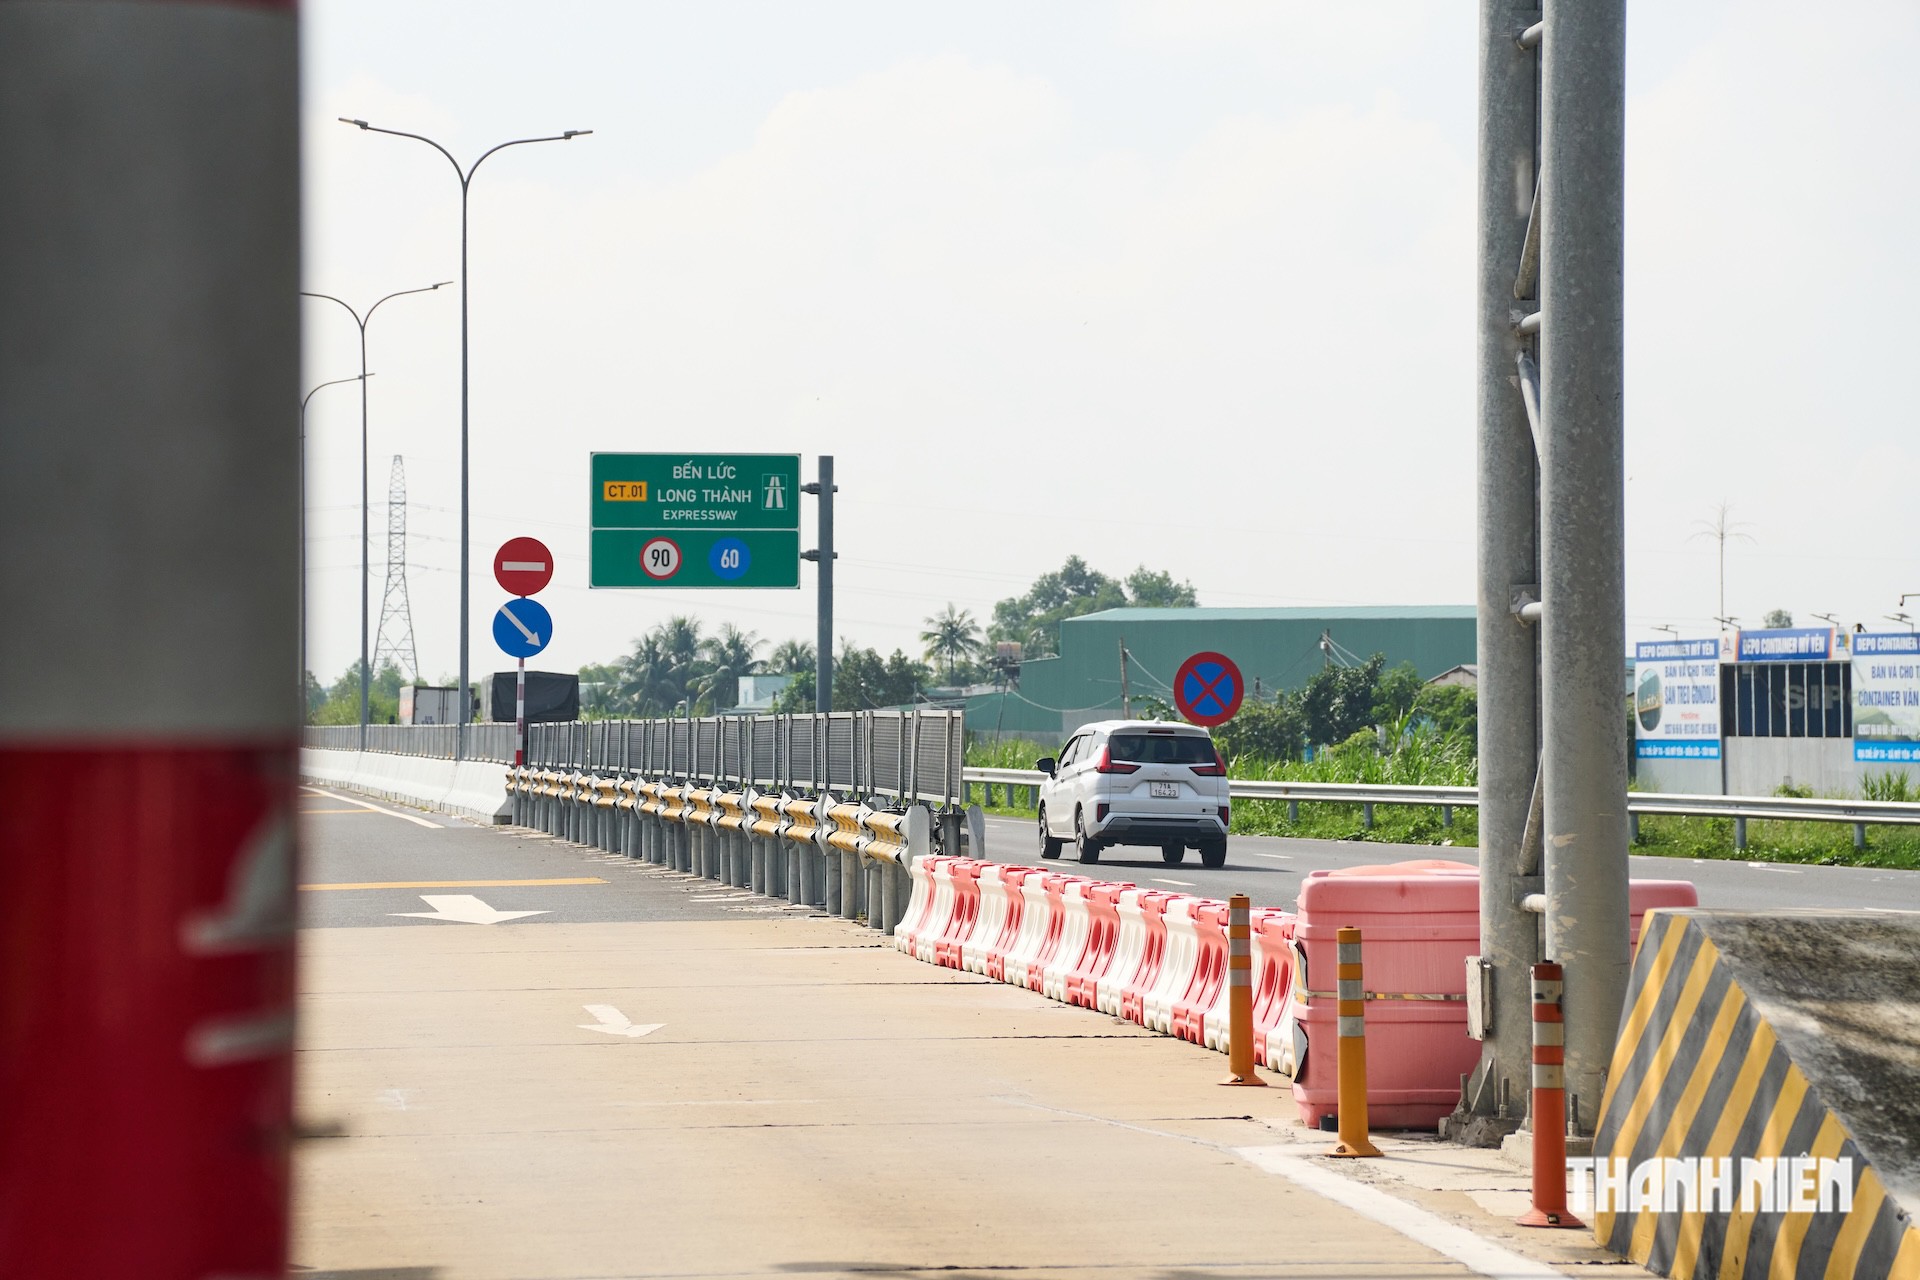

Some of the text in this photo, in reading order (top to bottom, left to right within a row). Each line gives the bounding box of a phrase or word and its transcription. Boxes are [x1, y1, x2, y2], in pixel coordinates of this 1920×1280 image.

[673, 460, 736, 480] BẾN LỨC
[608, 485, 643, 498] CT.01
[657, 485, 752, 503] LONG THÀNH
[663, 510, 738, 520] EXPRESSWAY
[651, 549, 670, 567] 90
[720, 549, 739, 568] 60
[1640, 645, 1655, 658] DEPO
[1742, 638, 1760, 654] DEPO
[1761, 636, 1797, 654] CONTAINER
[1857, 637, 1918, 651] DEPO CONTAINER
[1900, 665, 1913, 678] CHO
[1858, 690, 1900, 706] CONTAINER
